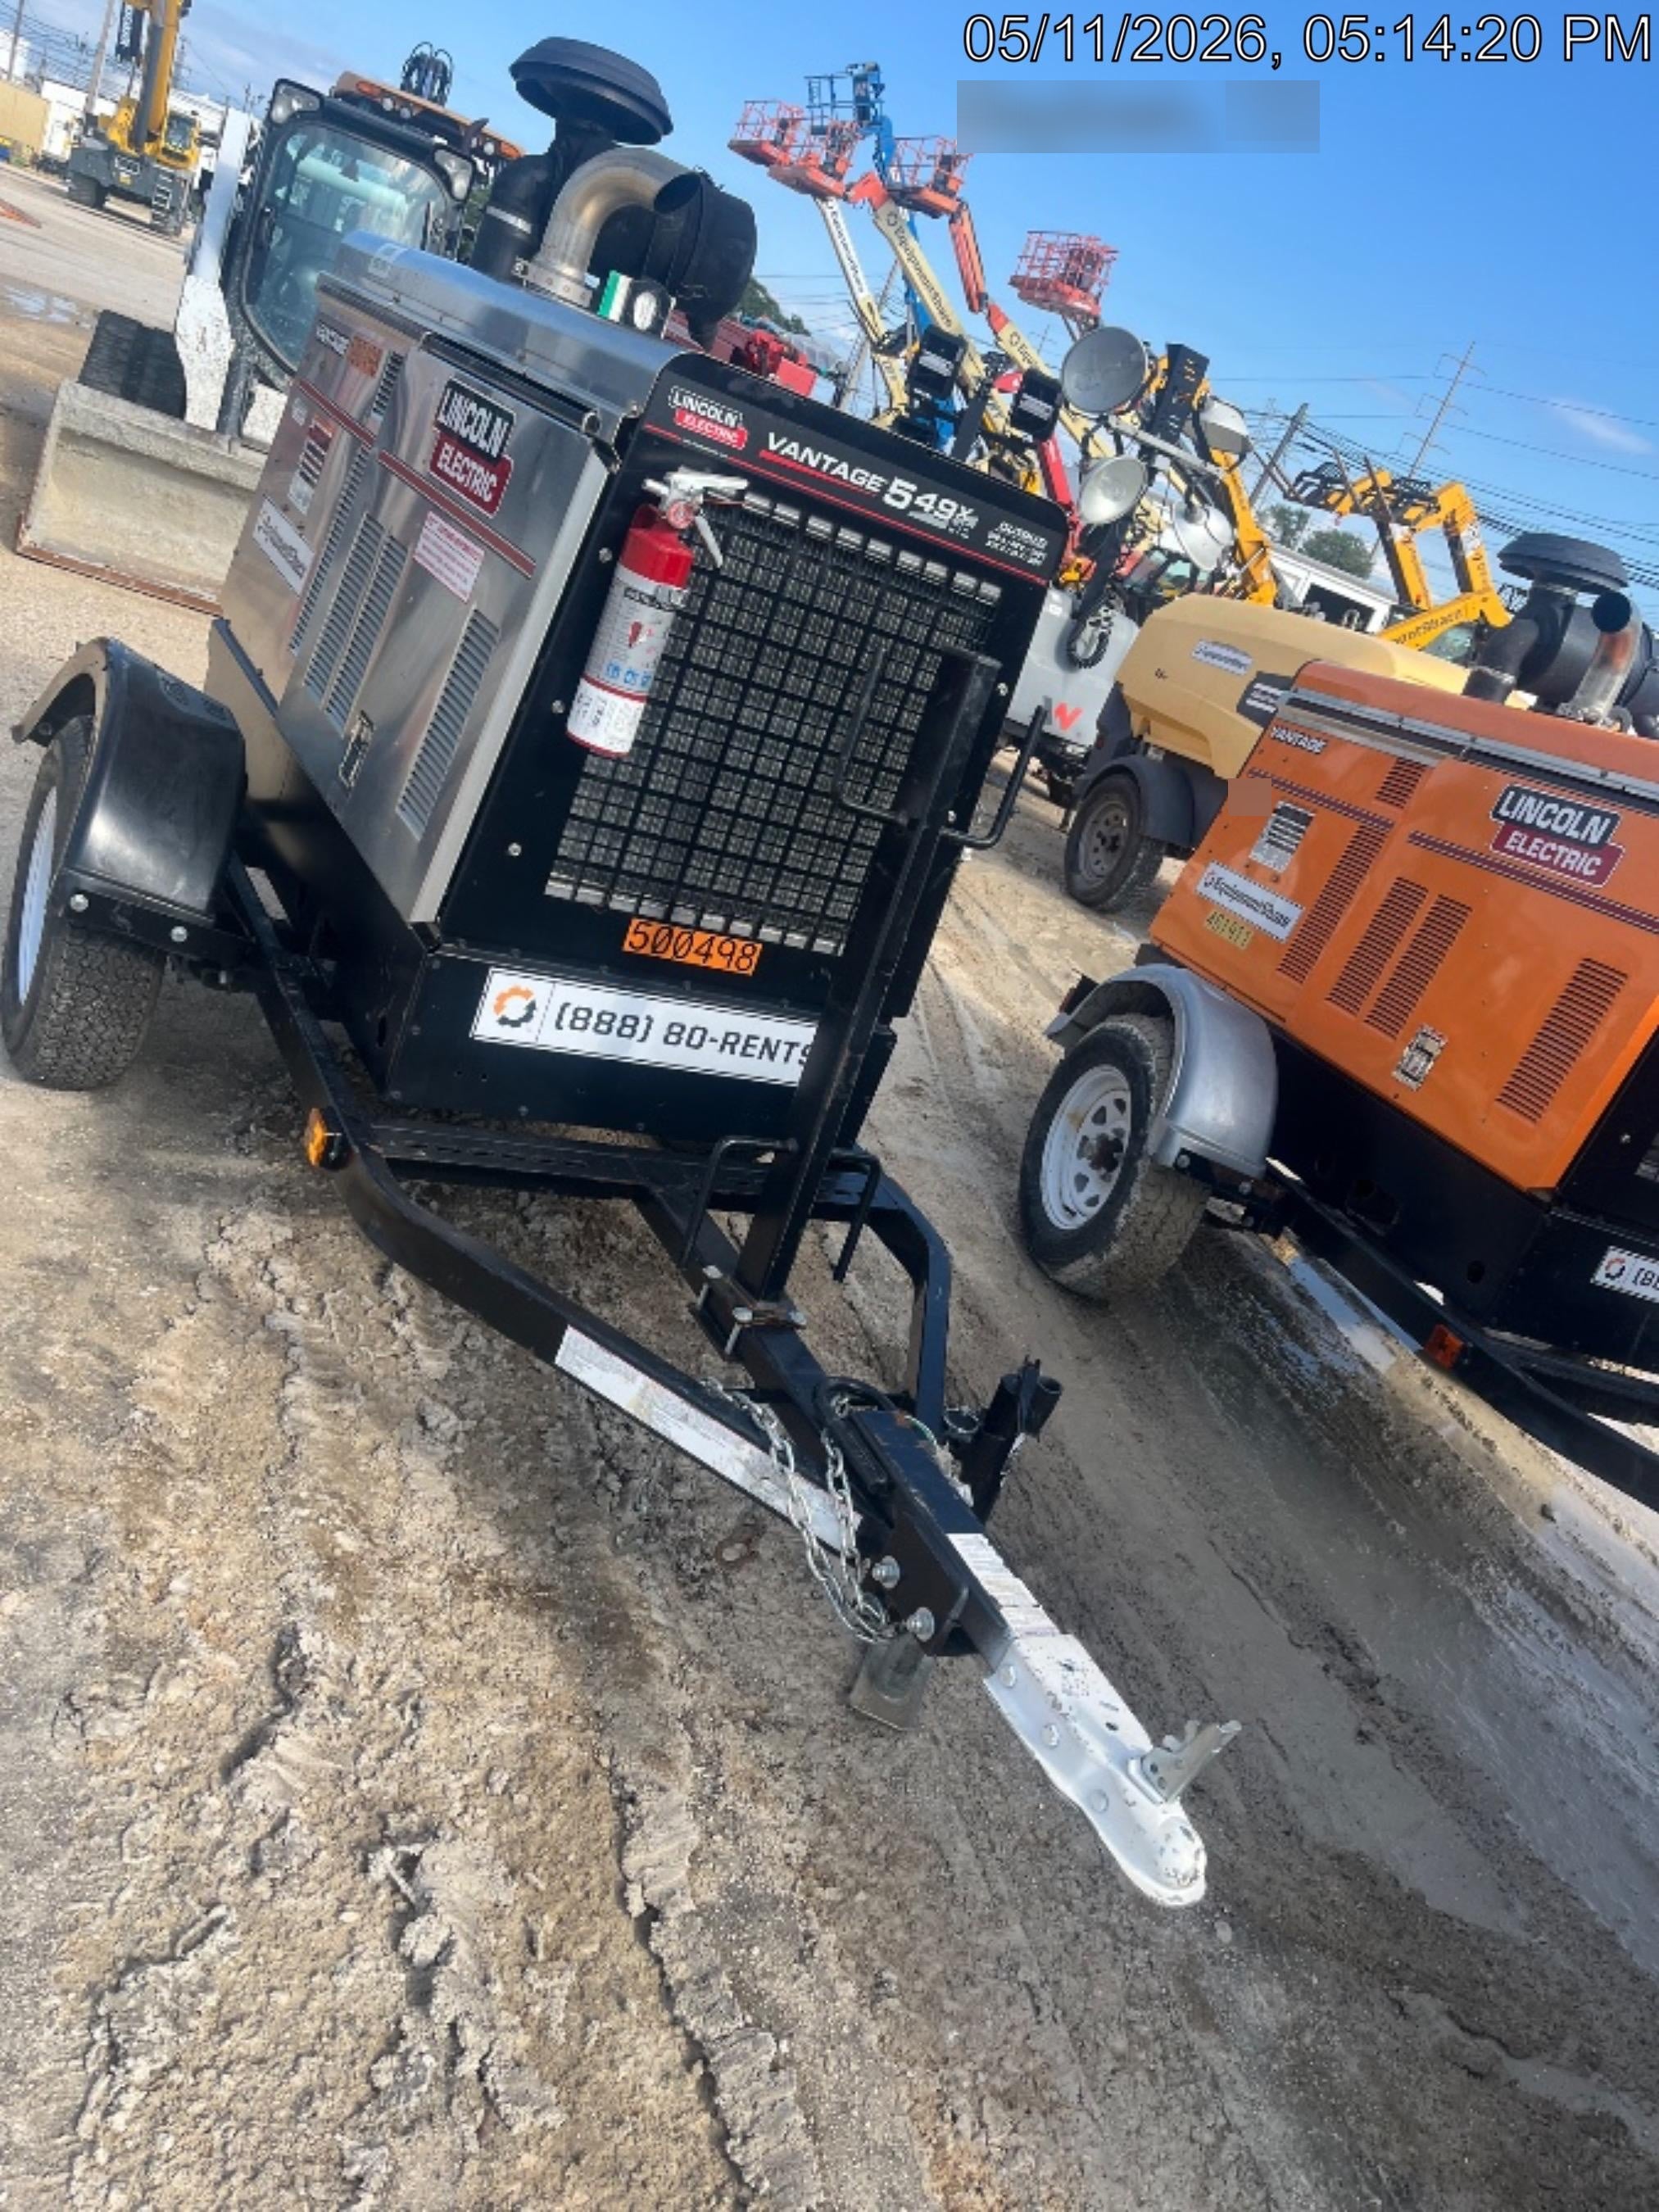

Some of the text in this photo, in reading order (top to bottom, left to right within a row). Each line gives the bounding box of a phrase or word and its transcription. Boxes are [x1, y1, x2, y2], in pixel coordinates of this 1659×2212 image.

[437, 388, 509, 458] LINCOLN
[675, 391, 737, 428] LINCOLN
[683, 415, 739, 444] ELECTRIC
[437, 442, 498, 502] ELECTRIC
[768, 432, 887, 492] VANTAGE
[1498, 791, 1611, 844] LINCOLN
[1504, 830, 1601, 876] ELECTRIC
[1214, 877, 1292, 929] EquipmentShare
[628, 921, 757, 972] 500498
[555, 1002, 654, 1043] (888)
